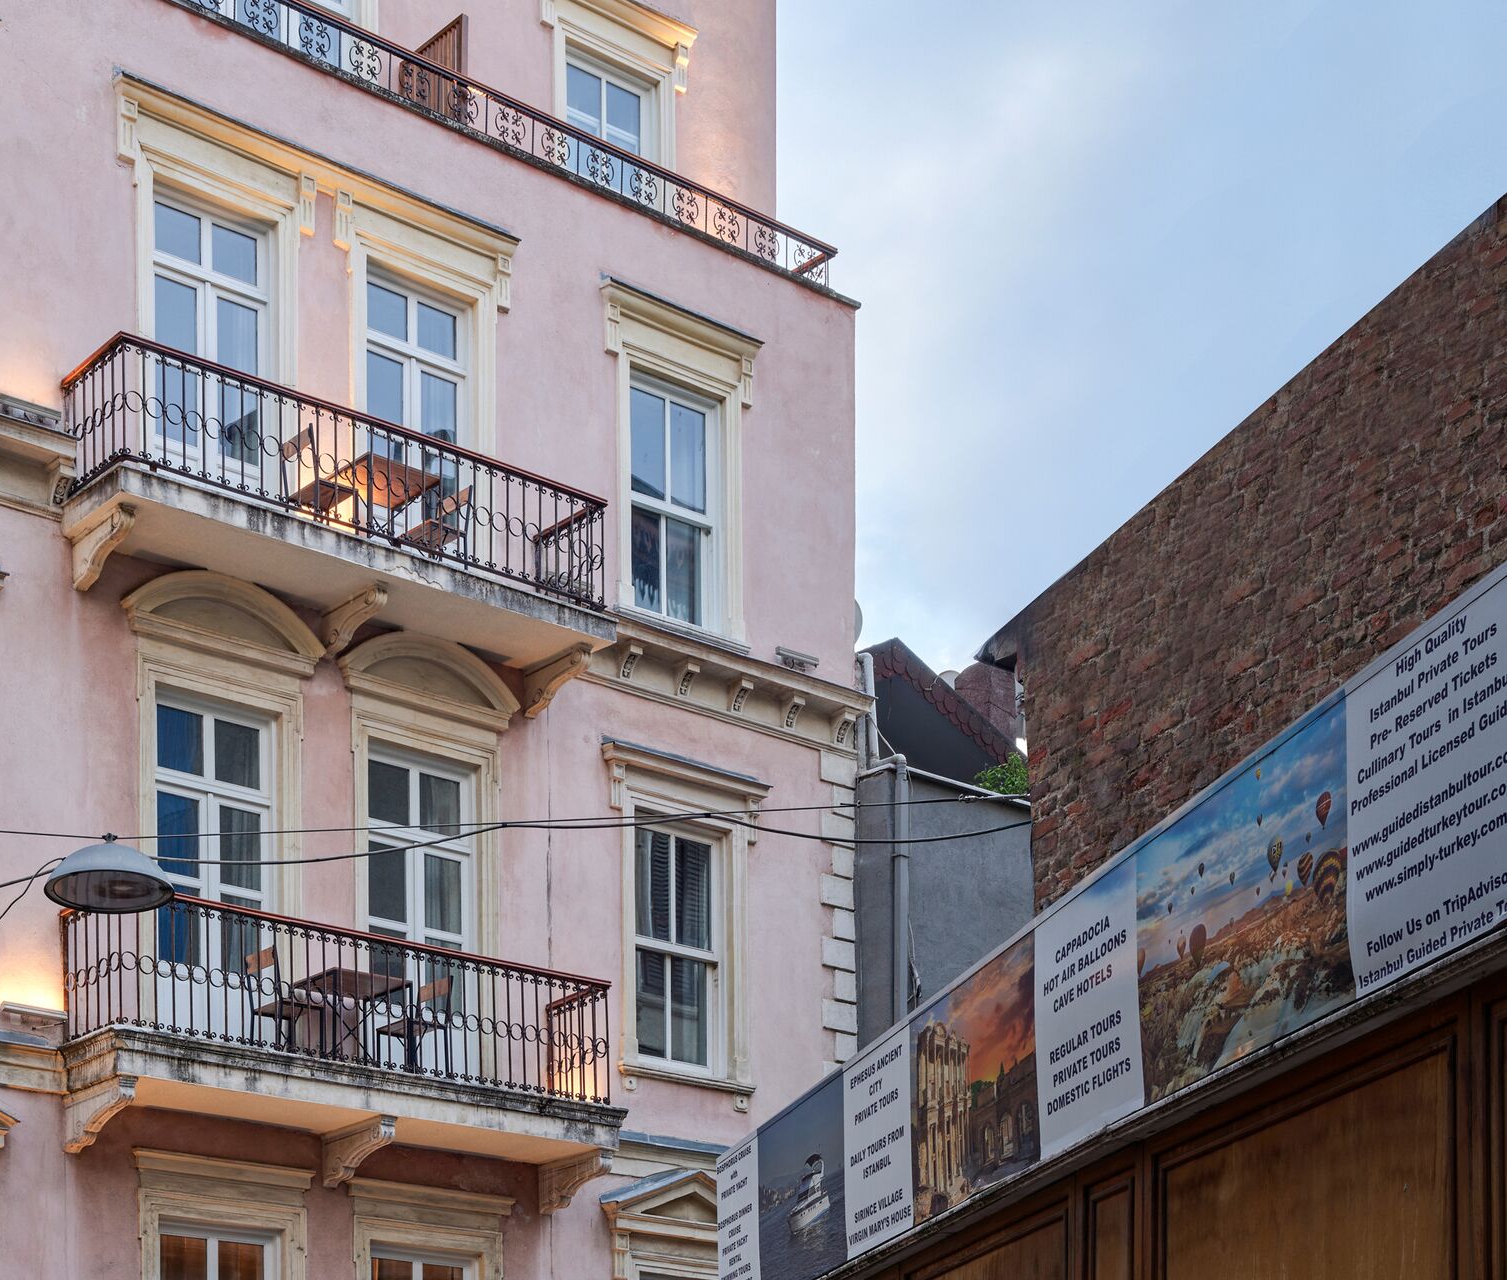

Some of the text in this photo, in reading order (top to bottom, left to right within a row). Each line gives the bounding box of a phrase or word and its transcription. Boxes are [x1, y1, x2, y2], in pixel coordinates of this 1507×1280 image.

[1396, 616, 1466, 677] High Quality
[1370, 623, 1497, 723] Istanbul Private Tours
[1370, 652, 1497, 749] Pre- Reserved Tickets
[1351, 760, 1418, 816] Professional
[1422, 722, 1475, 770] Licensed
[1358, 744, 1406, 784] Cullinary
[1409, 720, 1441, 749] Tours
[1449, 708, 1459, 723] in
[1055, 916, 1110, 963] CAPPADOCIA
[1358, 911, 1493, 989] Istanbul Guided Private
[1367, 929, 1403, 957] Follow
[1406, 919, 1422, 935] Us
[1426, 909, 1440, 925] on
[1044, 929, 1126, 996] HOT AIR BALLOONS
[1053, 964, 1112, 1012] CAVE HOTELS
[1050, 1010, 1121, 1065] REGULAR TOURS
[850, 1044, 902, 1089] EPHESUS ANCIENT
[1053, 1037, 1120, 1087] PRIVATE TOURS
[855, 1088, 898, 1125] PRIVATE TOURS
[869, 1078, 882, 1096] CITY
[1047, 1057, 1131, 1116] DOMESTIC FLIGHTS
[738, 1144, 752, 1161] CRUISE
[850, 1125, 905, 1167] DAILY TOURS FROM
[863, 1154, 891, 1179] ISTANBUL
[848, 1205, 911, 1246] VIRGIN MARY'S HOUSE
[854, 1188, 903, 1223] SIRINCE VILLAGE
